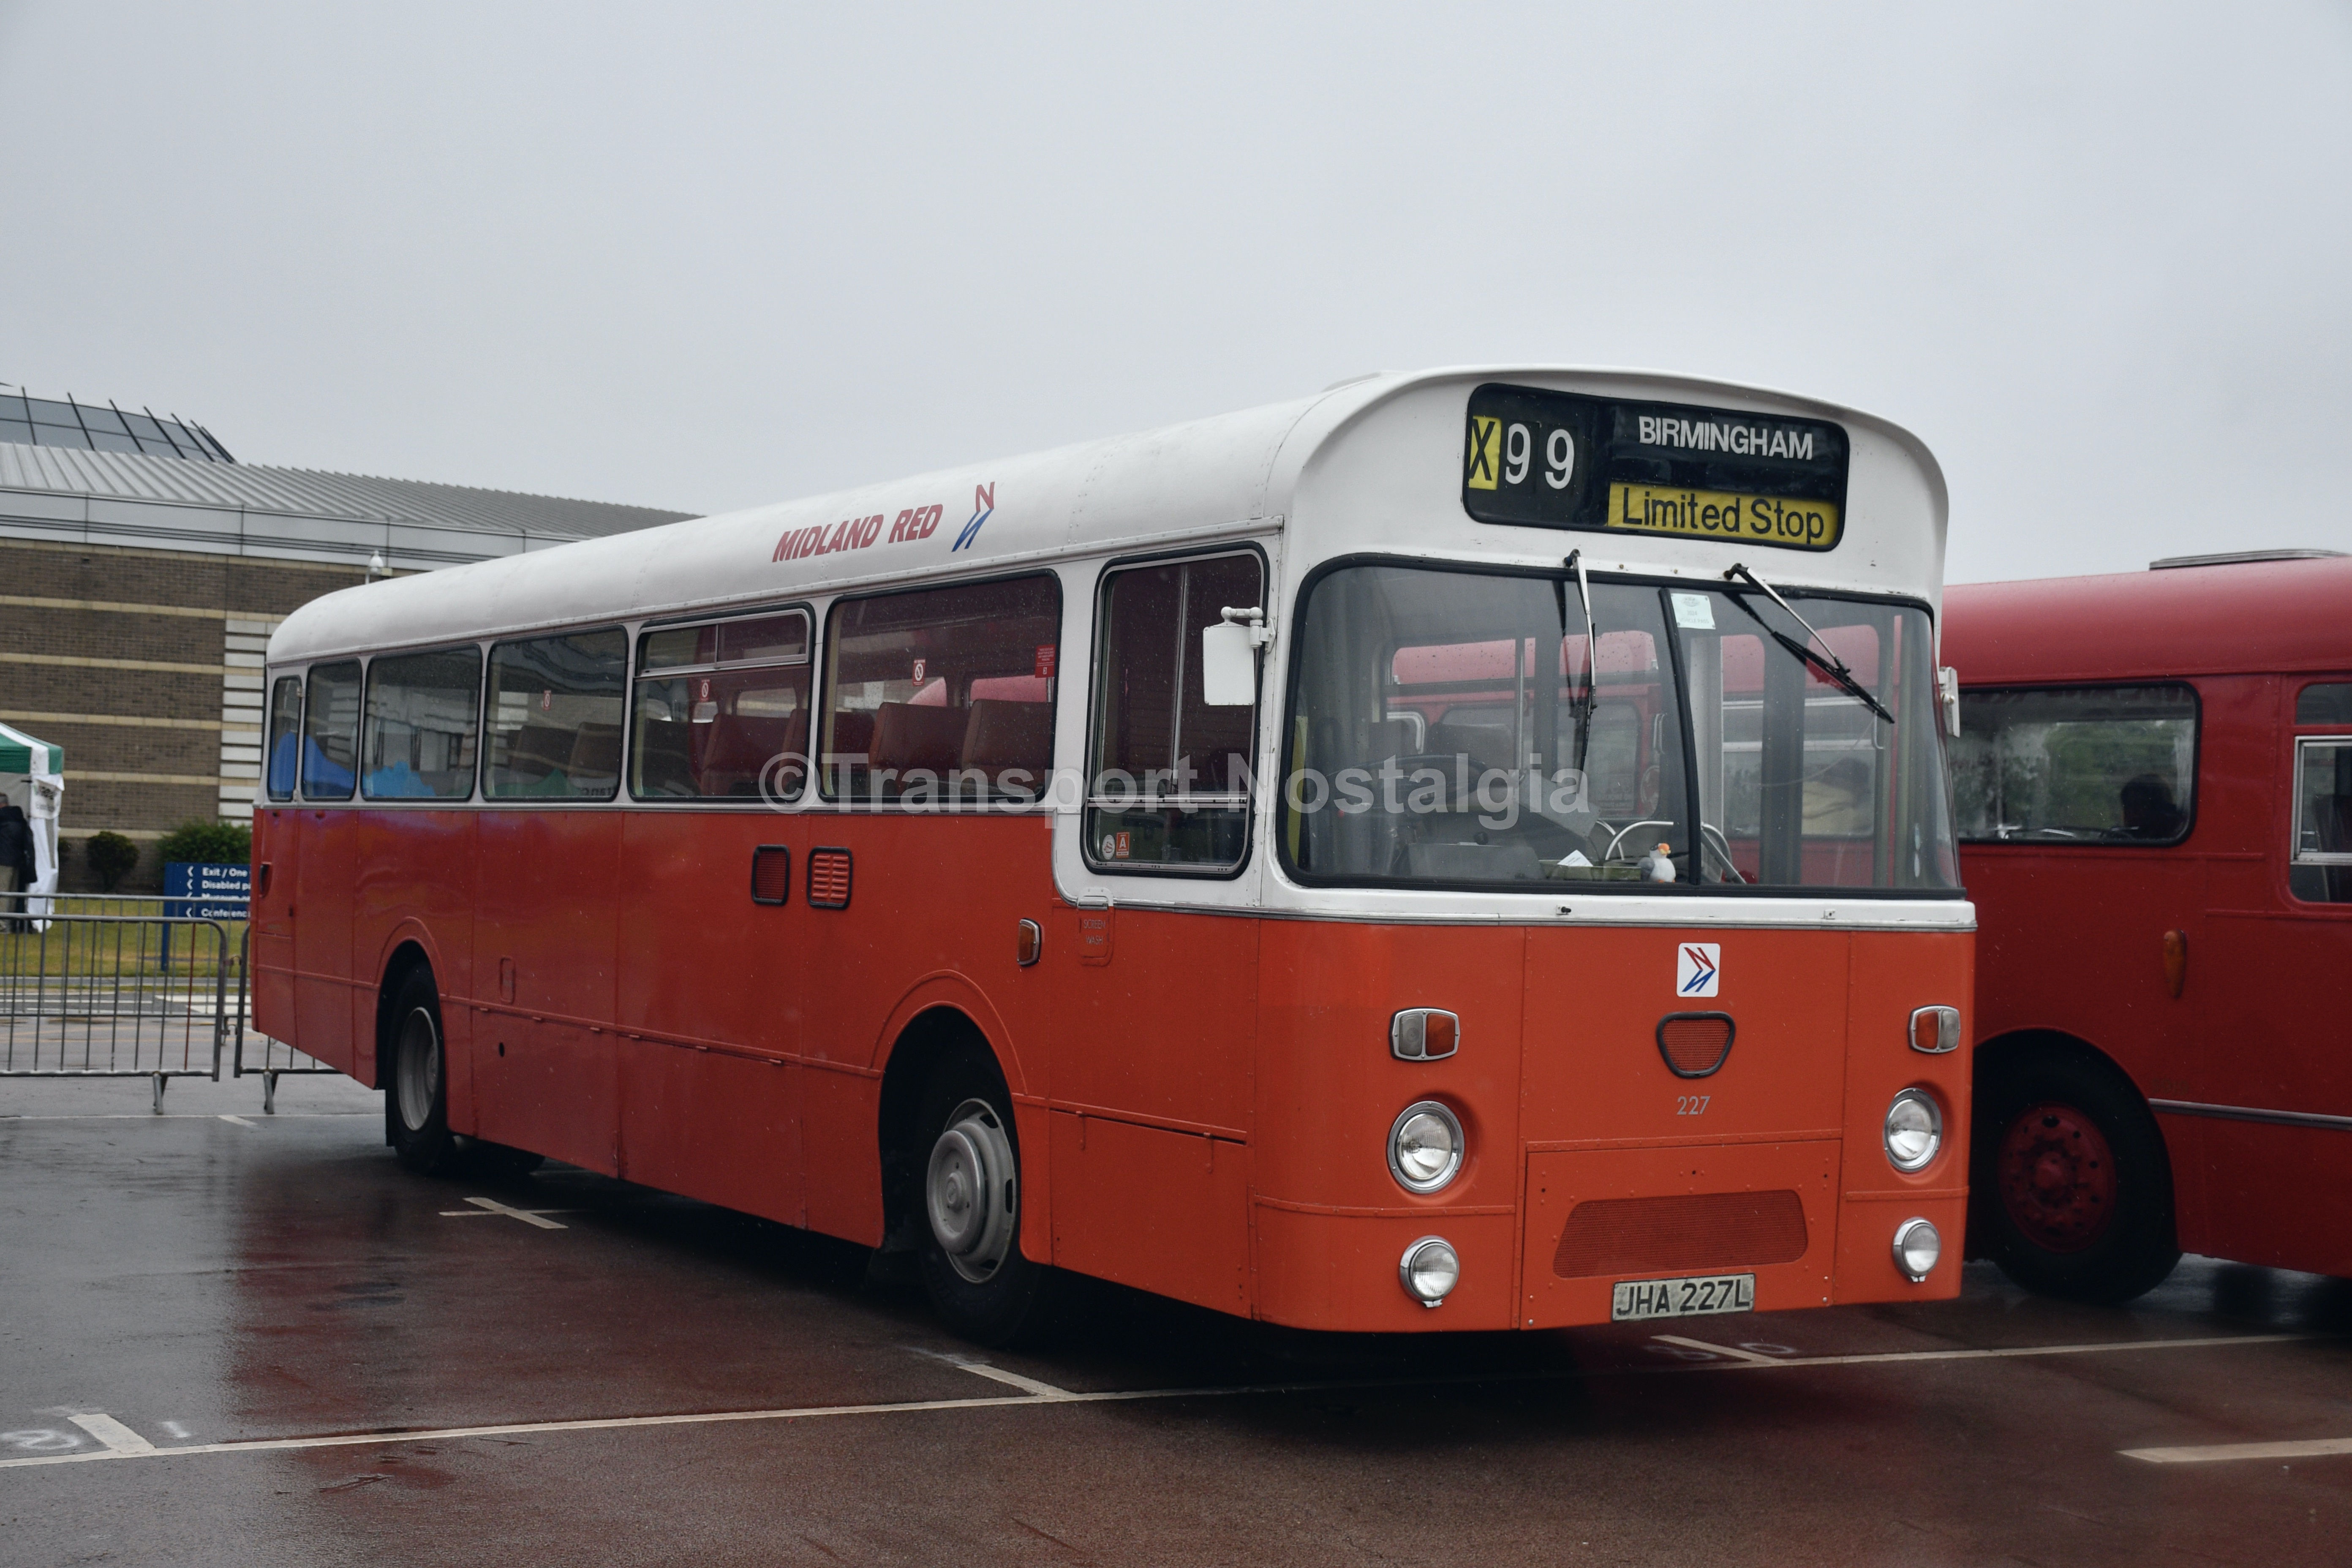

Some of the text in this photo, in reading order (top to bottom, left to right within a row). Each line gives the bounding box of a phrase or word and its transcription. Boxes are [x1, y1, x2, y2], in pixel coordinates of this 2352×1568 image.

[1639, 416, 1813, 460] BIRMINGHAM
[1622, 487, 1824, 544] Limited Stop
[772, 504, 943, 562] MIDLAND RED
[203, 867, 248, 879] Exit / One
[201, 880, 241, 890] Disabled
[1083, 919, 1106, 929] SCREEN
[1086, 935, 1103, 945] WASH
[1677, 1095, 1711, 1115] 227
[1616, 1279, 1750, 1315] JHA 227L
